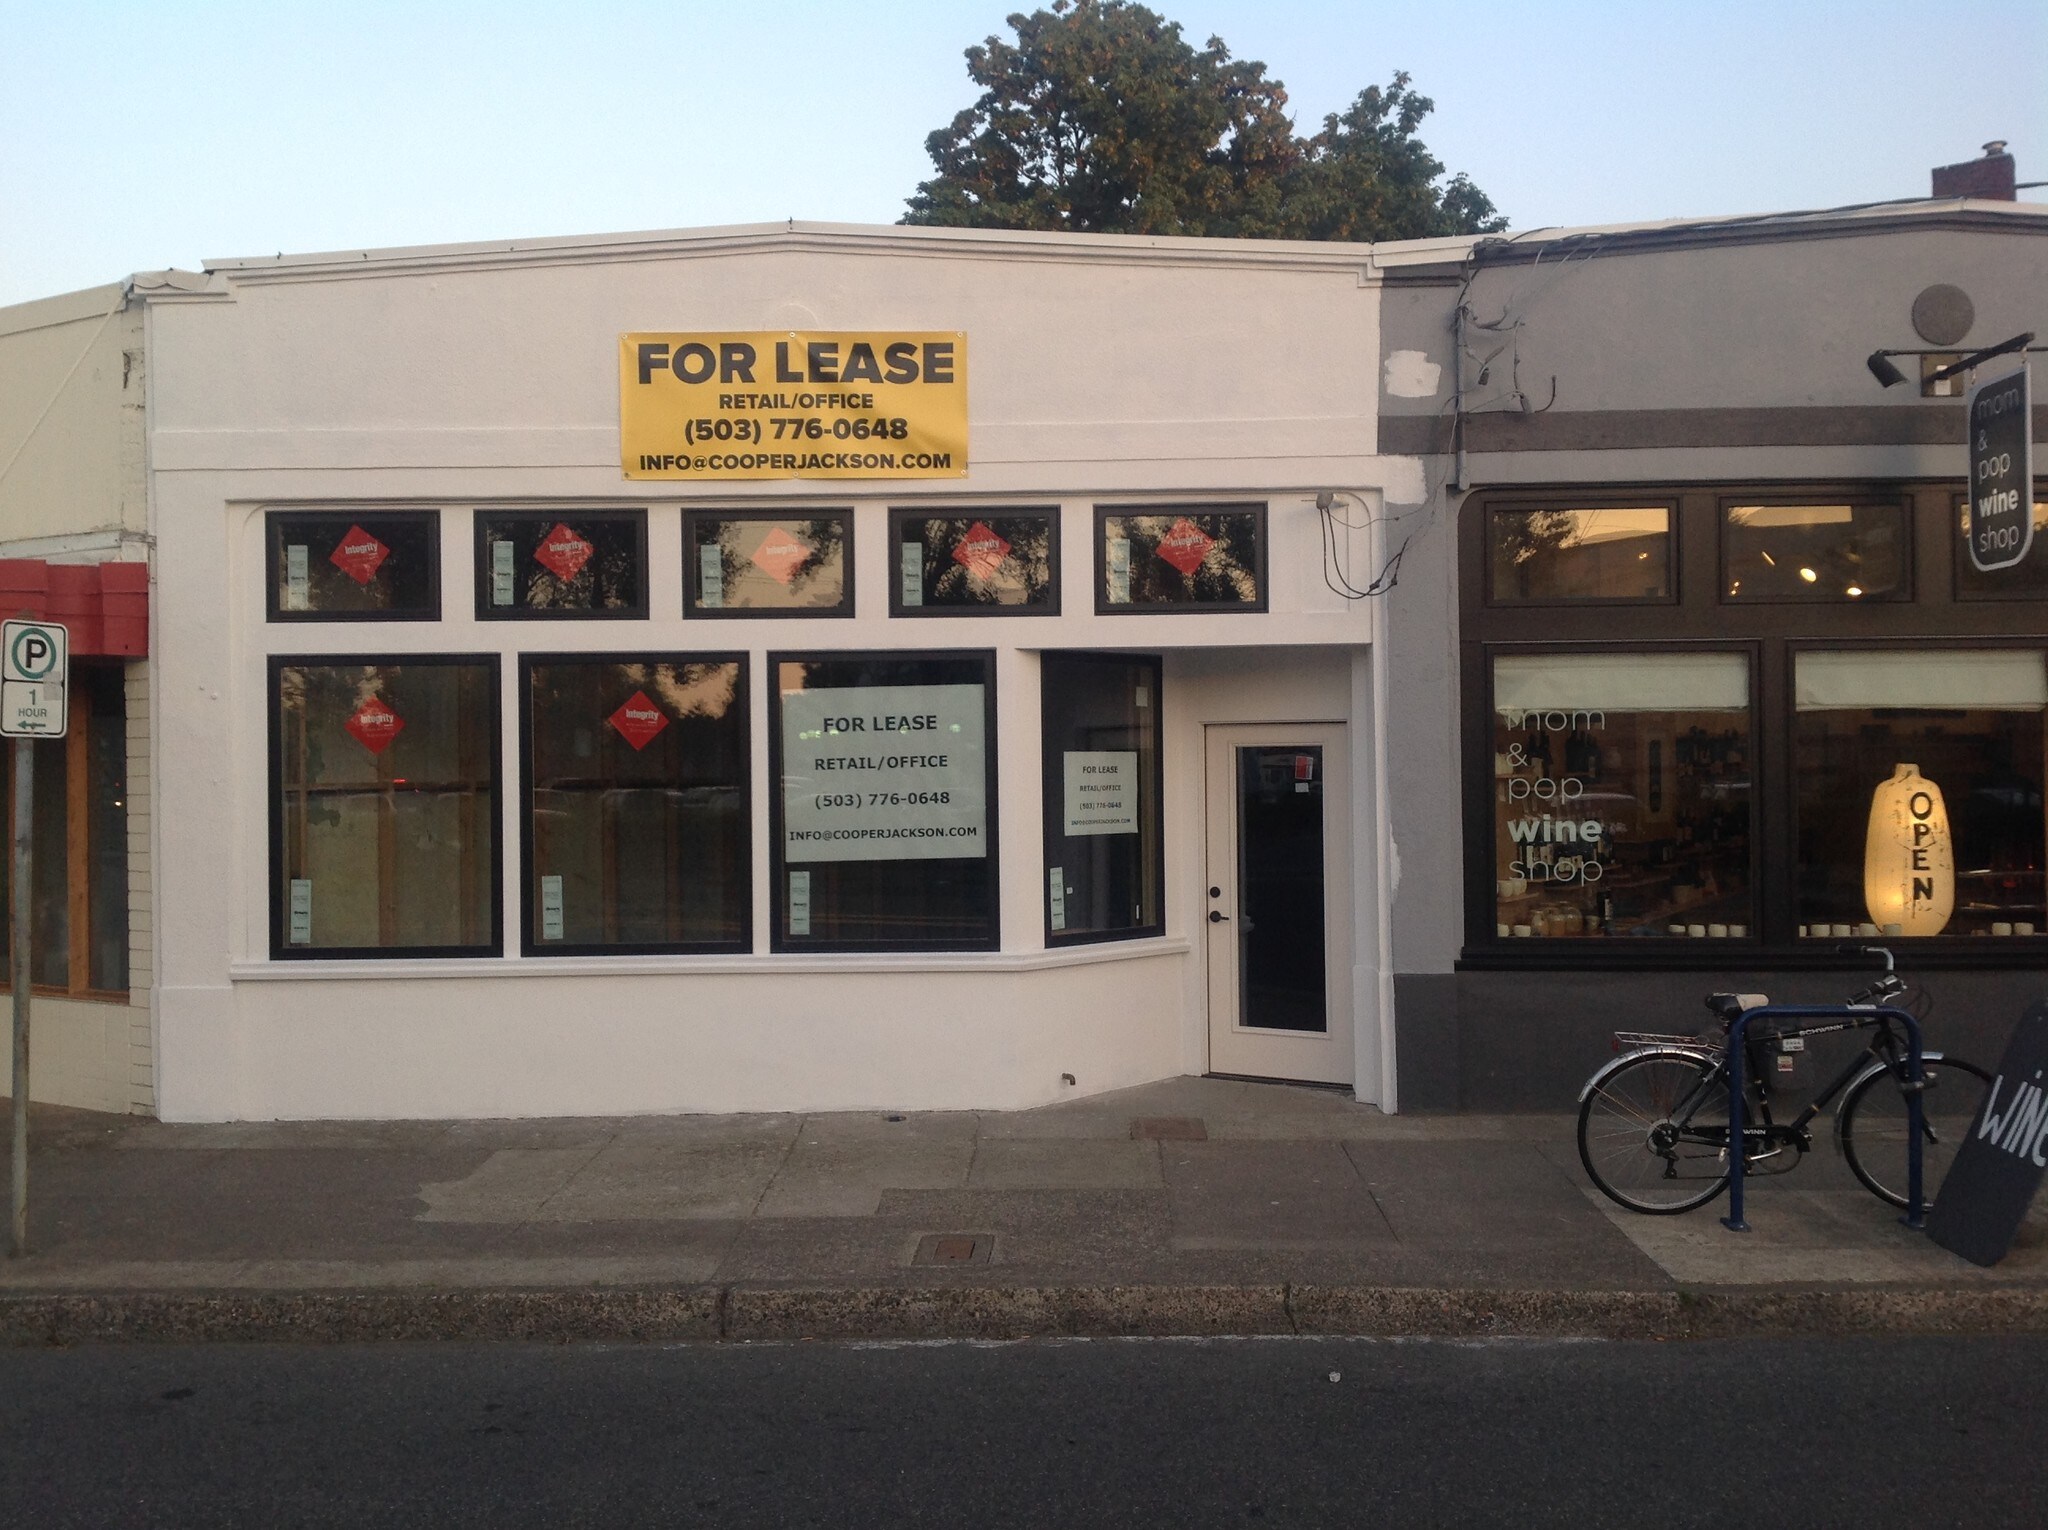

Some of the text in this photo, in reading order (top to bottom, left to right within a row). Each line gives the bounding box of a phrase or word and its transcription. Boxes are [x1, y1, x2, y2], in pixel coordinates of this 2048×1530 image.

[638, 341, 954, 384] FOR LEASE
[719, 393, 873, 409] RETAIL/OFFICE
[1978, 388, 2019, 419] mom
[684, 418, 908, 446] (503) 776-0648
[1978, 428, 1988, 451] &
[640, 453, 951, 471] INFO@COOPERJACKSON.COM
[1978, 453, 2011, 484] pop
[1979, 487, 2019, 518] wine
[344, 541, 378, 555] Integrity
[1979, 524, 2020, 553] shop
[25, 639, 47, 668] P
[29, 688, 36, 705] 1
[18, 708, 47, 718] HOUR
[360, 713, 394, 725] Integrity
[625, 709, 659, 721] Integrity
[823, 715, 938, 733] FOR LEASE
[1507, 710, 1605, 731] mom
[815, 755, 948, 771] RETAIL/OFFICE
[1507, 743, 1528, 767] &
[815, 792, 950, 810] (503) 776-0648
[1508, 777, 1584, 805] pop
[789, 827, 977, 841] INFO@COOPERJACKSON.COM
[1507, 814, 1603, 843] wine
[1910, 791, 1933, 901] OPEN
[1509, 850, 1603, 886] shop
[1799, 1024, 1844, 1036] SCHWINN
